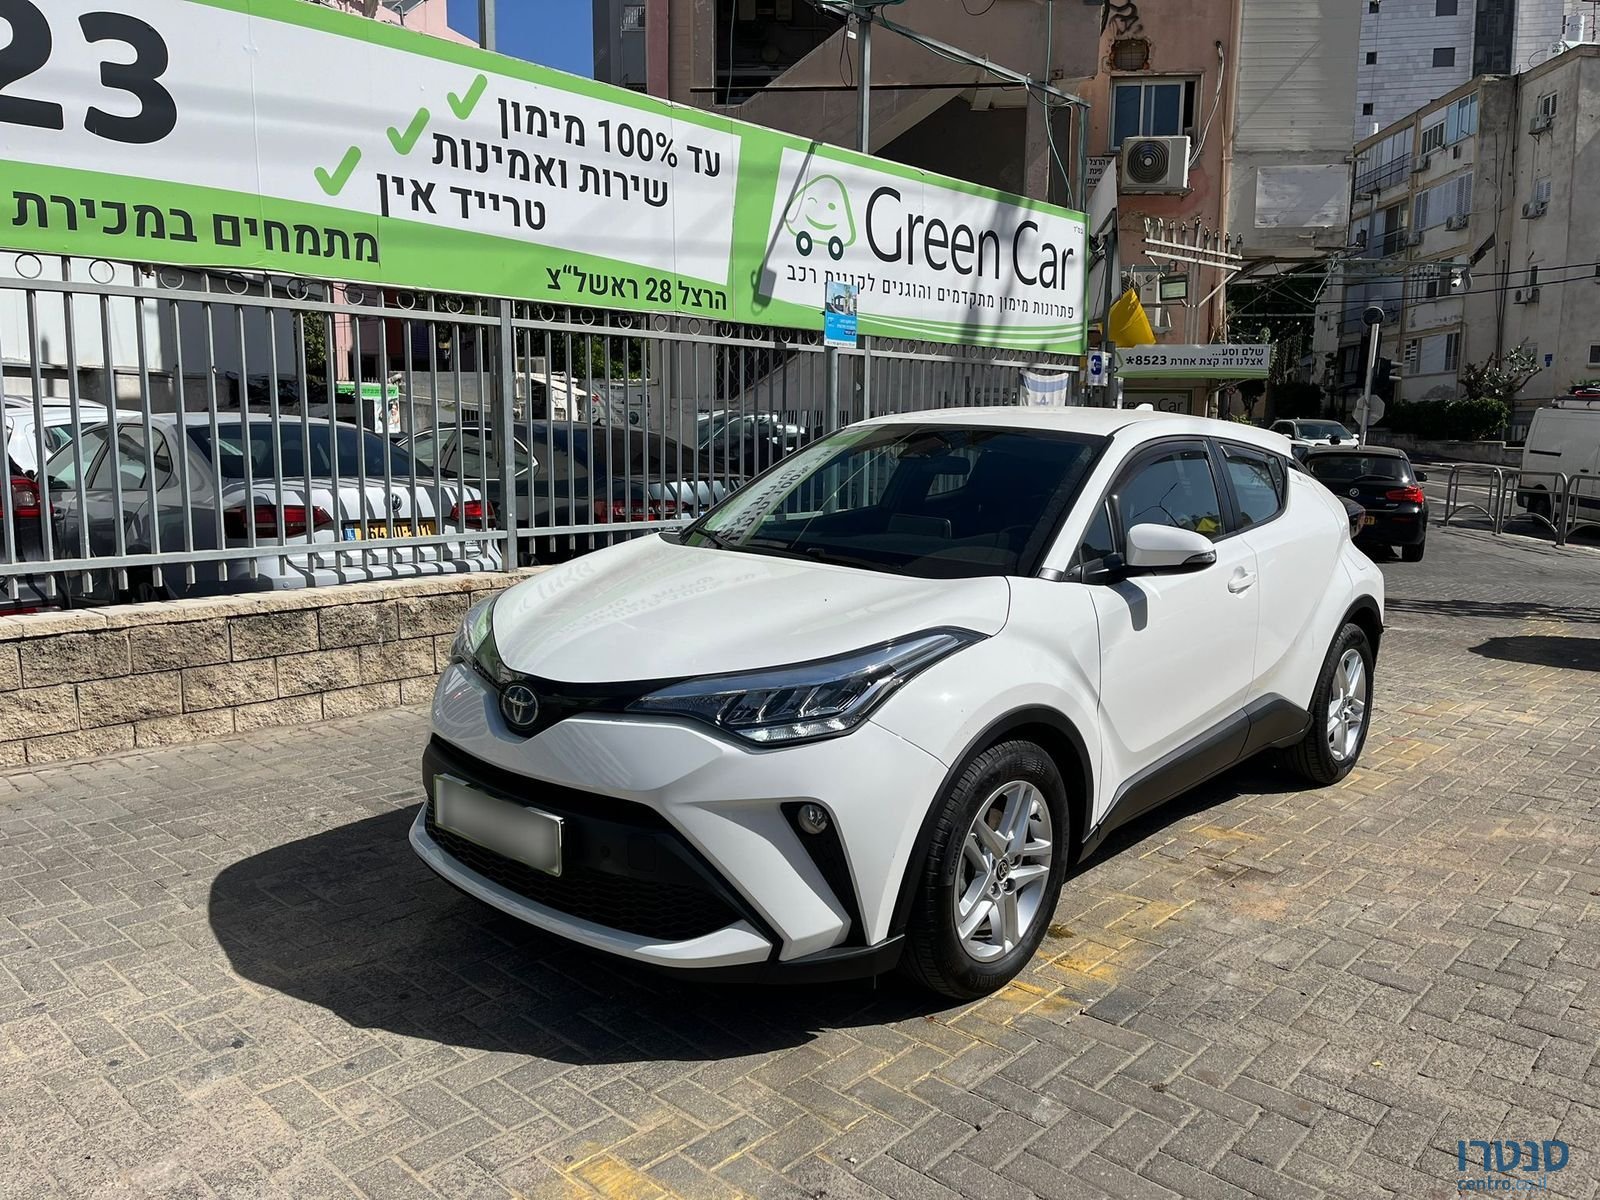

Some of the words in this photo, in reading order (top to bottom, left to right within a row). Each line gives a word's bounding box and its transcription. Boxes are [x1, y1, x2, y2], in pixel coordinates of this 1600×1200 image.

[498, 97, 586, 147] מימון
[597, 119, 678, 169] 100%
[432, 132, 568, 189] ואמינות
[686, 145, 721, 178] עד
[1089, 158, 1105, 166] הרצל
[376, 173, 437, 218] אין
[578, 163, 669, 208] שירות
[12, 190, 198, 243] במכירת
[449, 185, 547, 231] טרייד
[212, 213, 380, 264] מתמחים
[865, 186, 1001, 280] Green
[1012, 219, 1075, 291] Car
[786, 264, 818, 284] רכב
[645, 277, 673, 303] 28
[677, 280, 727, 311] הרצל
[882, 279, 932, 300] והוגנים
[937, 289, 995, 311] מתקדמים
[1000, 297, 1028, 317] מימון
[1032, 300, 1075, 320] פתרונות
[1170, 357, 1197, 366] אחרת
[1199, 357, 1220, 368] קצת
[1222, 357, 1233, 366] זה
[1236, 355, 1264, 366] אצלנו
[1241, 347, 1264, 356] שלם
